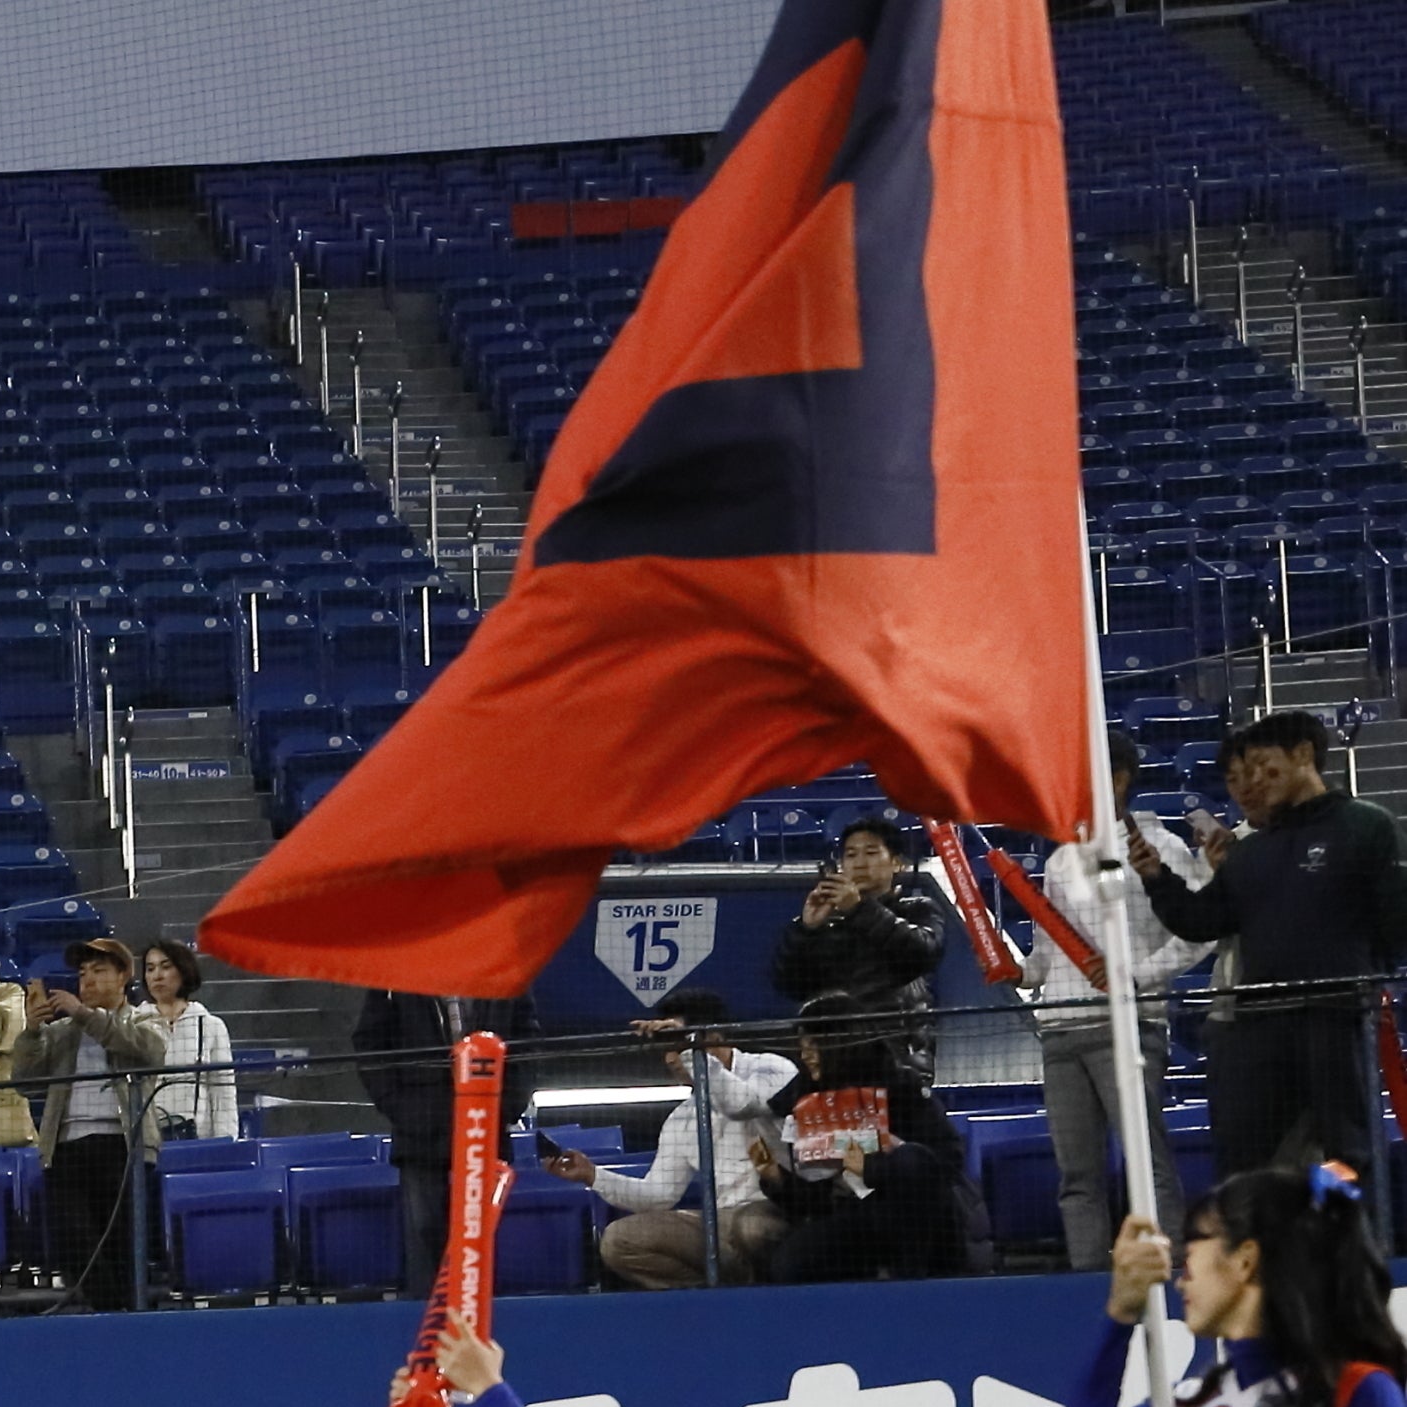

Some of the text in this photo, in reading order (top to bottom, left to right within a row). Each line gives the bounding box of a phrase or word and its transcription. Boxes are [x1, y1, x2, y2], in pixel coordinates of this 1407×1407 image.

[612, 903, 704, 918] STAR SIDE
[626, 920, 680, 972] 15
[635, 976, 667, 991] 通路
[471, 1057, 497, 1078] H
[460, 1144, 485, 1330] UNDER ARMO
